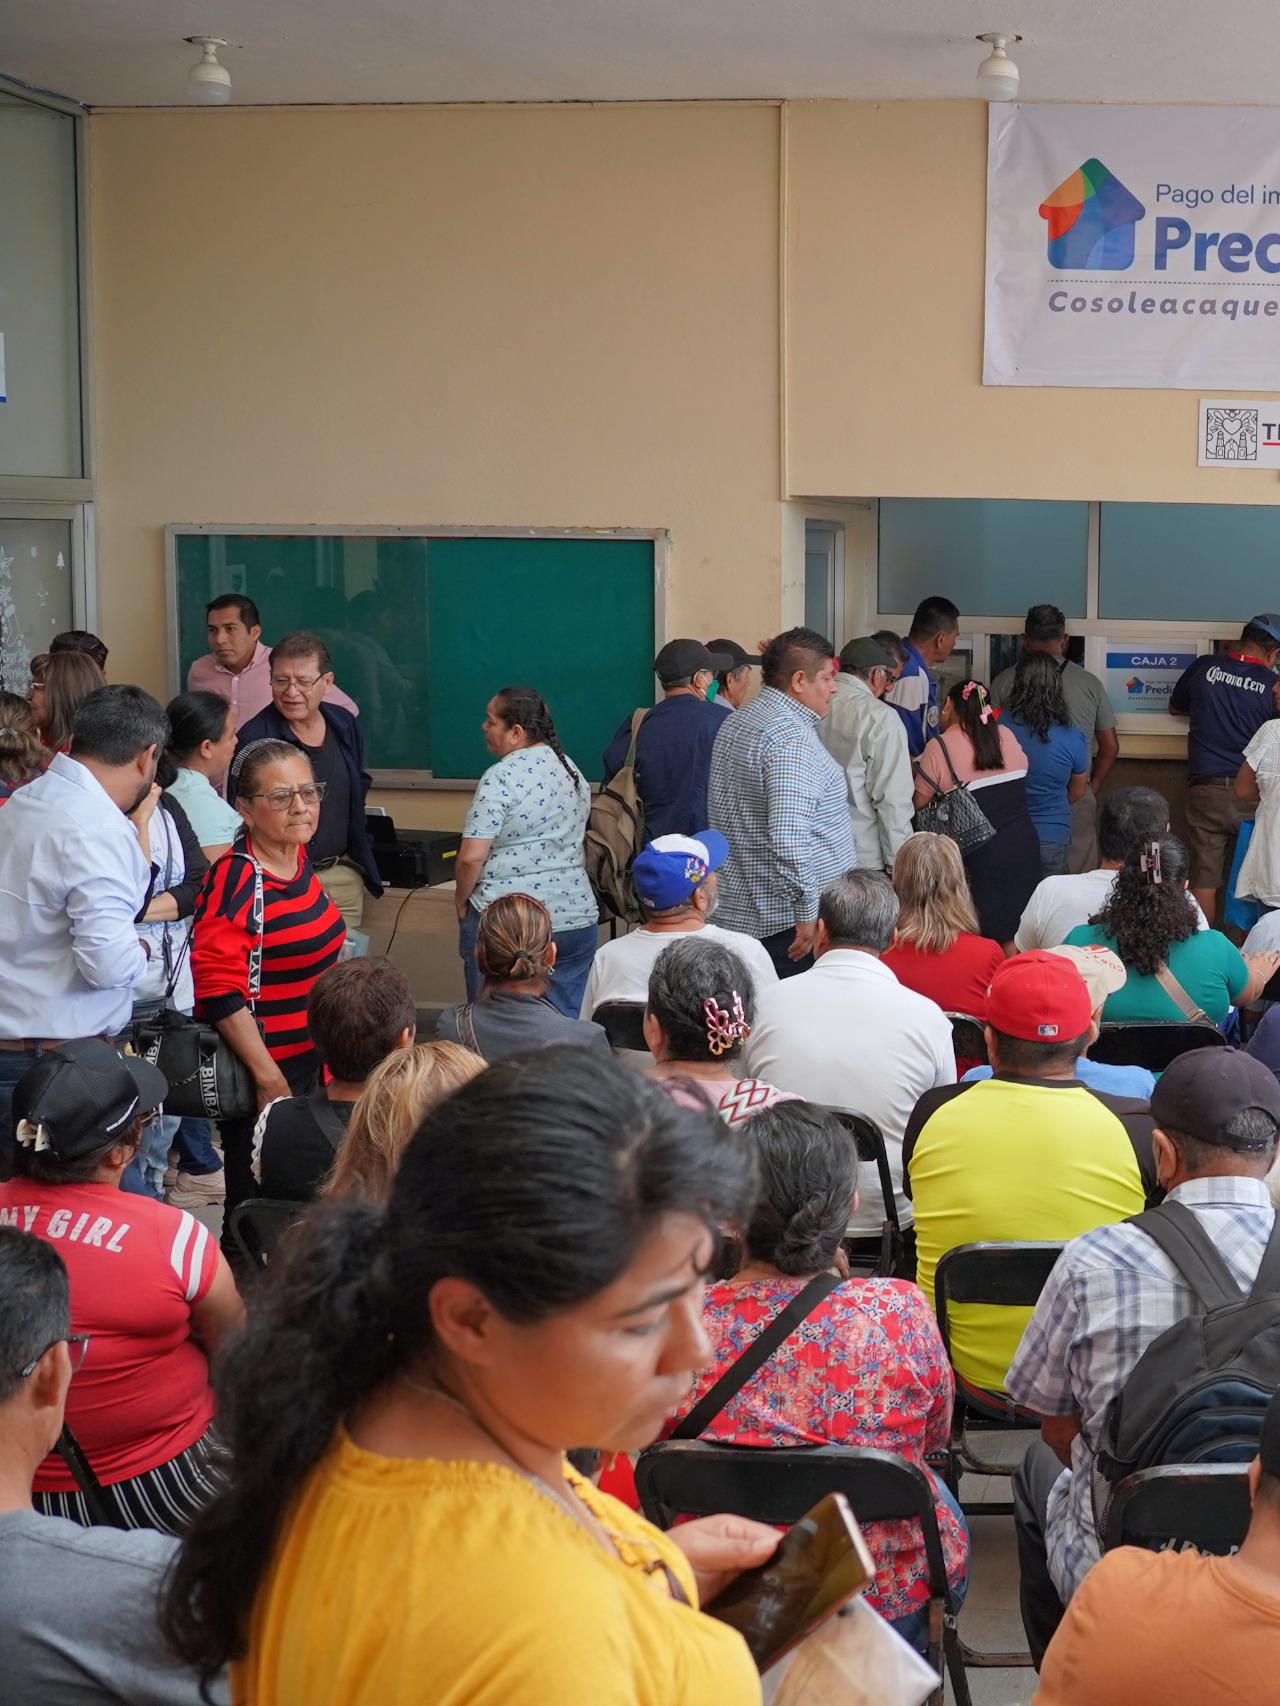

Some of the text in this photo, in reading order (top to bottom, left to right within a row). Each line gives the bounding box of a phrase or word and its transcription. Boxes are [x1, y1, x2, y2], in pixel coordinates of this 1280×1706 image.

[1156, 184, 1213, 208] Pago
[1221, 184, 1254, 204] del
[1048, 291, 1278, 320] Cosoleacaque
[1131, 656, 1177, 666] CAJA 2
[1206, 665, 1243, 687] Corona
[1145, 684, 1173, 694] Predi
[202, 1067, 219, 1117] BIMBA
[47, 1209, 130, 1253] GIRL
